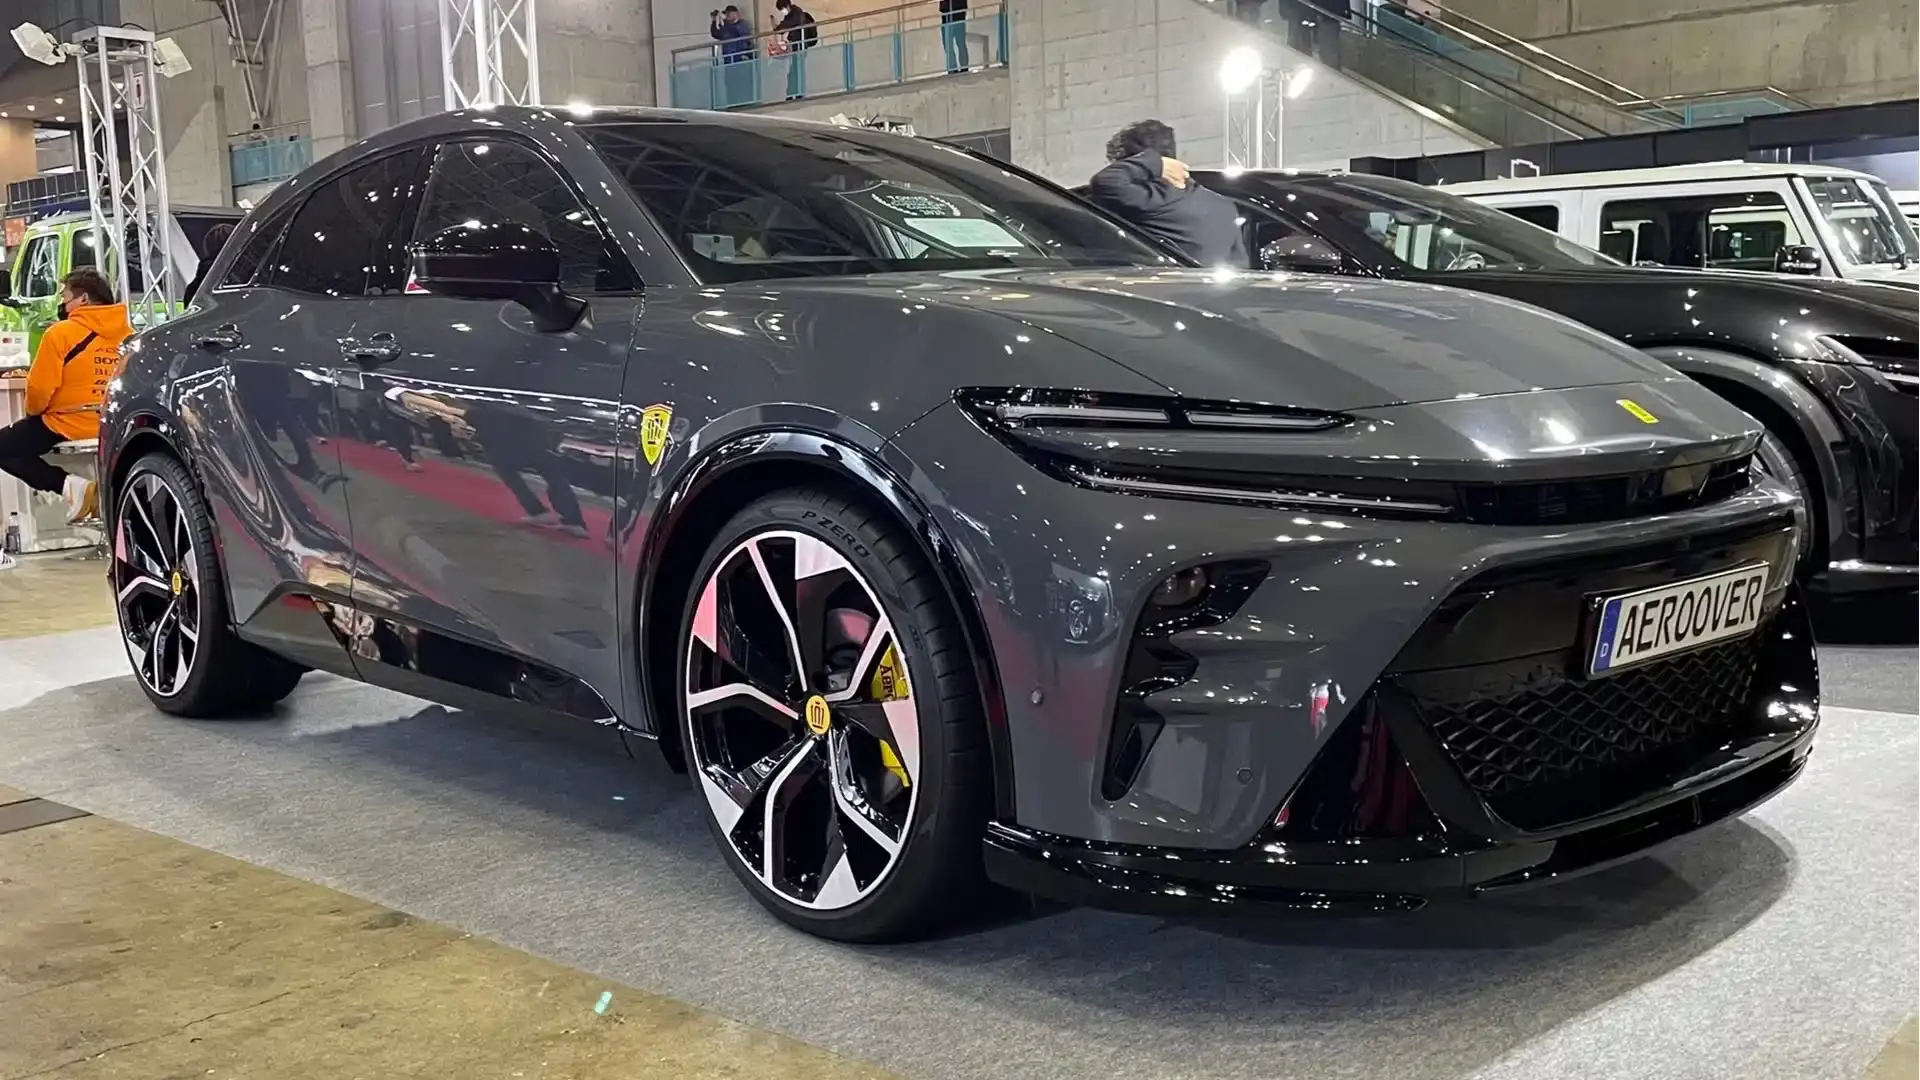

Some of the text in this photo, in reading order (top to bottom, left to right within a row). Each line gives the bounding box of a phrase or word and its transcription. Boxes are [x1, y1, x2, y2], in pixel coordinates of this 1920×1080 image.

[801, 511, 870, 558] P ZERO
[1616, 575, 1762, 659] AEROOVER
[1600, 643, 1609, 658] D
